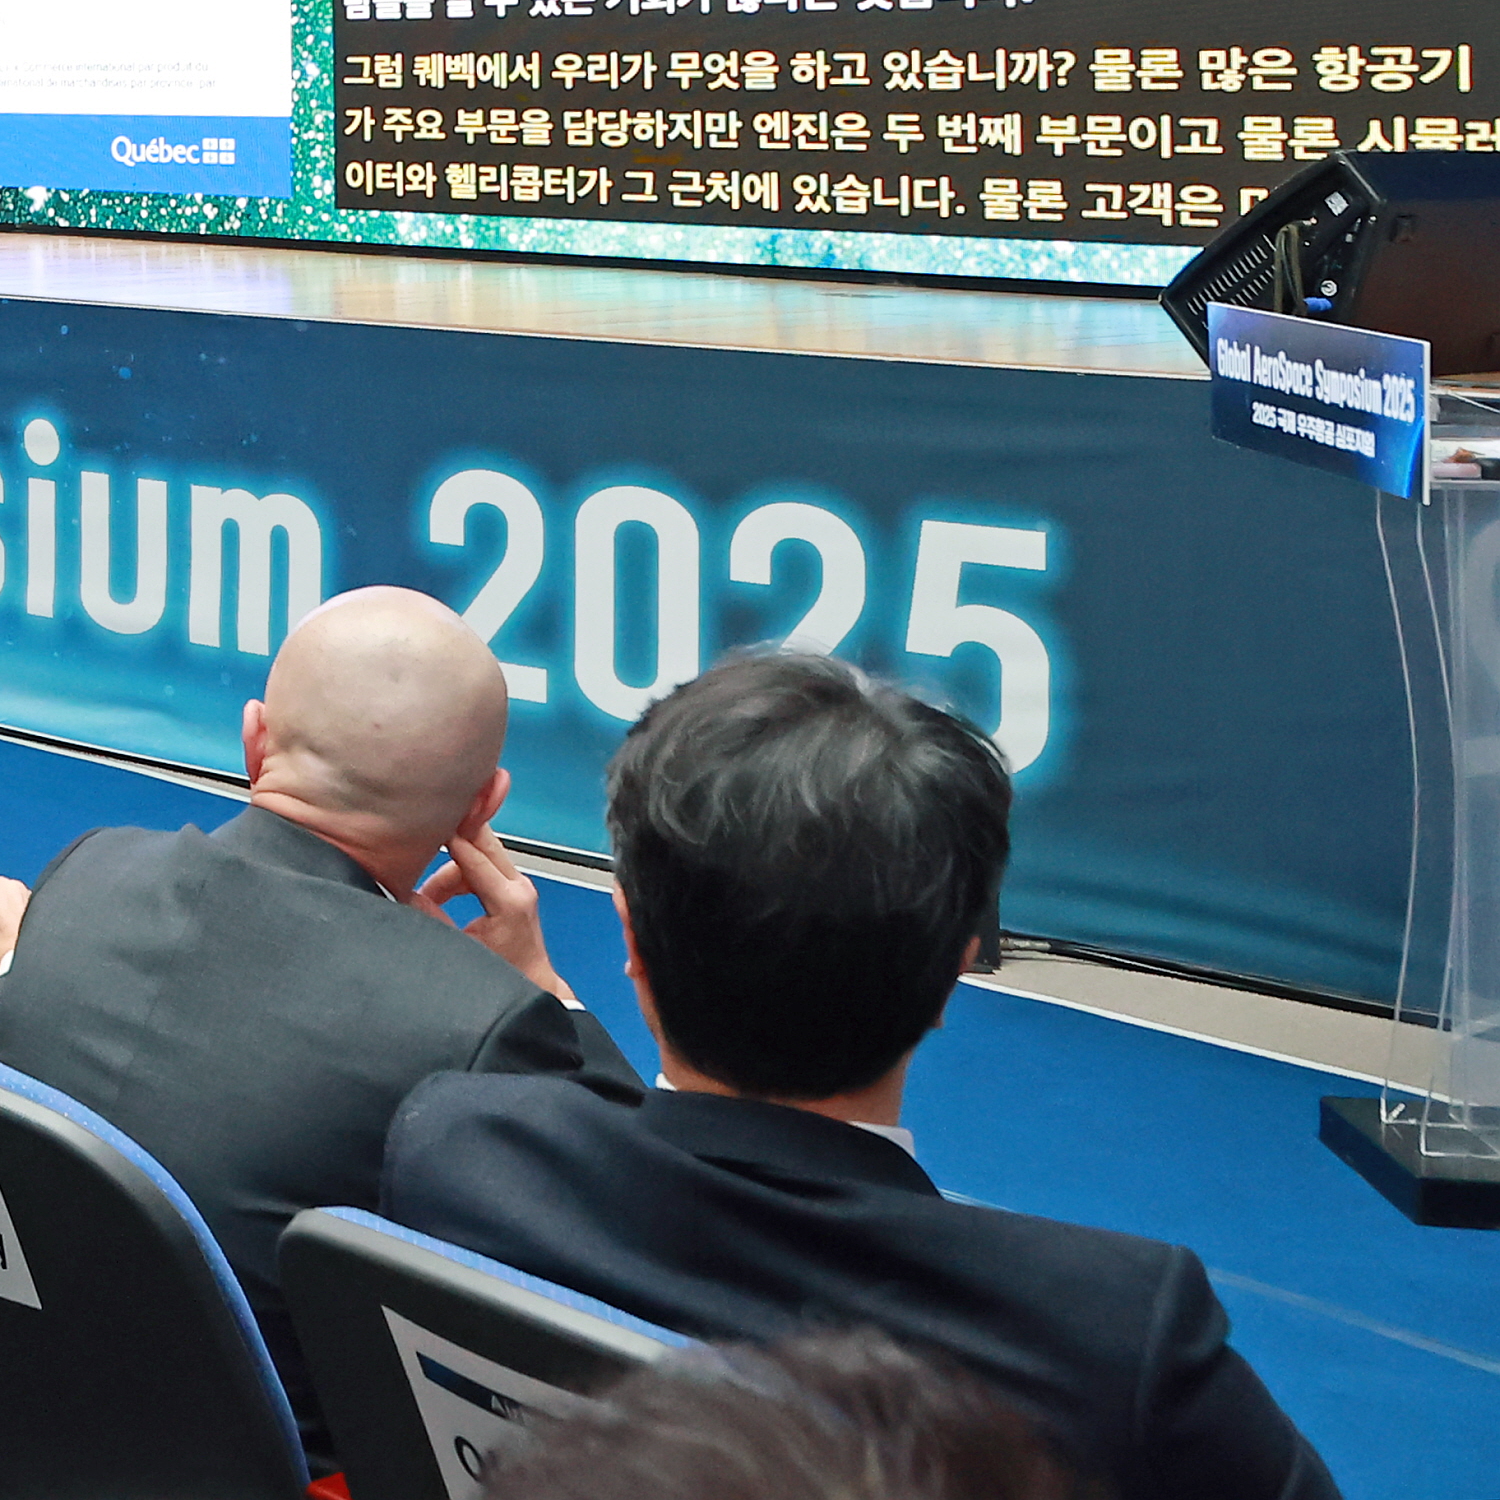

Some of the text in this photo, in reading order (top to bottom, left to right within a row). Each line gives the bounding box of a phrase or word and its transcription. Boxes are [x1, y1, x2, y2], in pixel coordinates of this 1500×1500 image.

[110, 134, 202, 167] Québec
[344, 160, 437, 198] 이터와
[445, 161, 613, 203] 헬리콥터가
[620, 170, 659, 203] 그
[667, 169, 781, 211] 근처에
[791, 174, 967, 216] 있습니다.
[978, 177, 1069, 221] 물론
[1080, 181, 1224, 227] 고객은
[1217, 337, 1416, 423] Global AeroSpace Symposium 2025
[1252, 401, 1277, 428] 2025
[429, 468, 1052, 775] 2025
